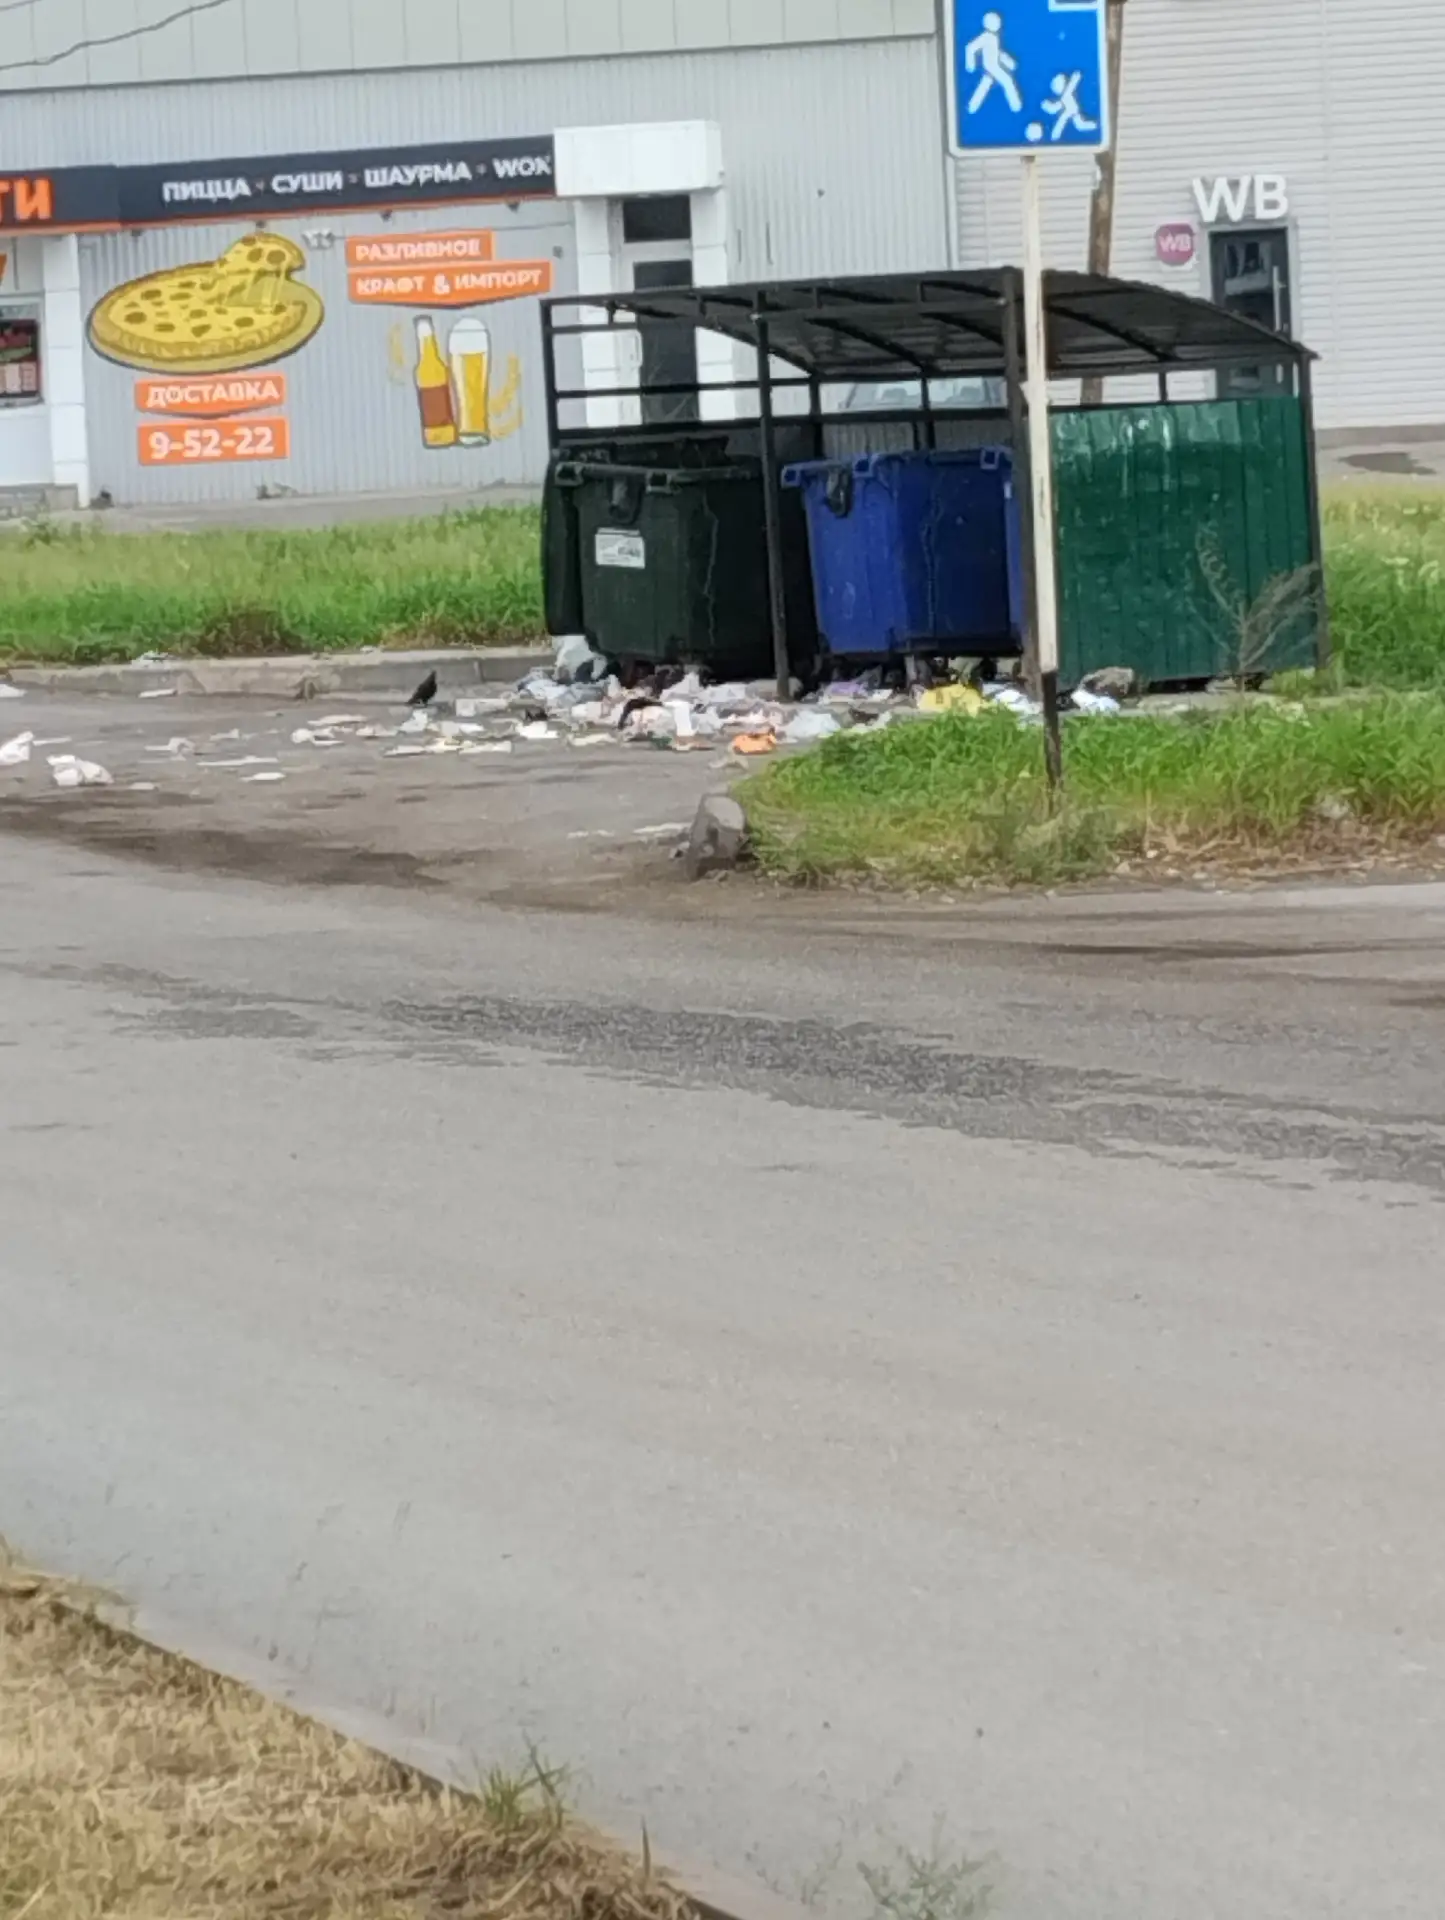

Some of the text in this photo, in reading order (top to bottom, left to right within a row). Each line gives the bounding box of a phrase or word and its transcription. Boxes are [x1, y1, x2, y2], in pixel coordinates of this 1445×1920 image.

[162, 155, 552, 203] ПИЦЦА СУШИ ШАУРМА WOK
[1192, 174, 1289, 223] WB
[354, 238, 482, 262] РАЗЛИВНОЕ
[355, 269, 543, 296] КРАФТ & ИМПОРТ
[146, 379, 281, 408] ДОСТАВКА
[148, 425, 275, 460] 9-52-22
